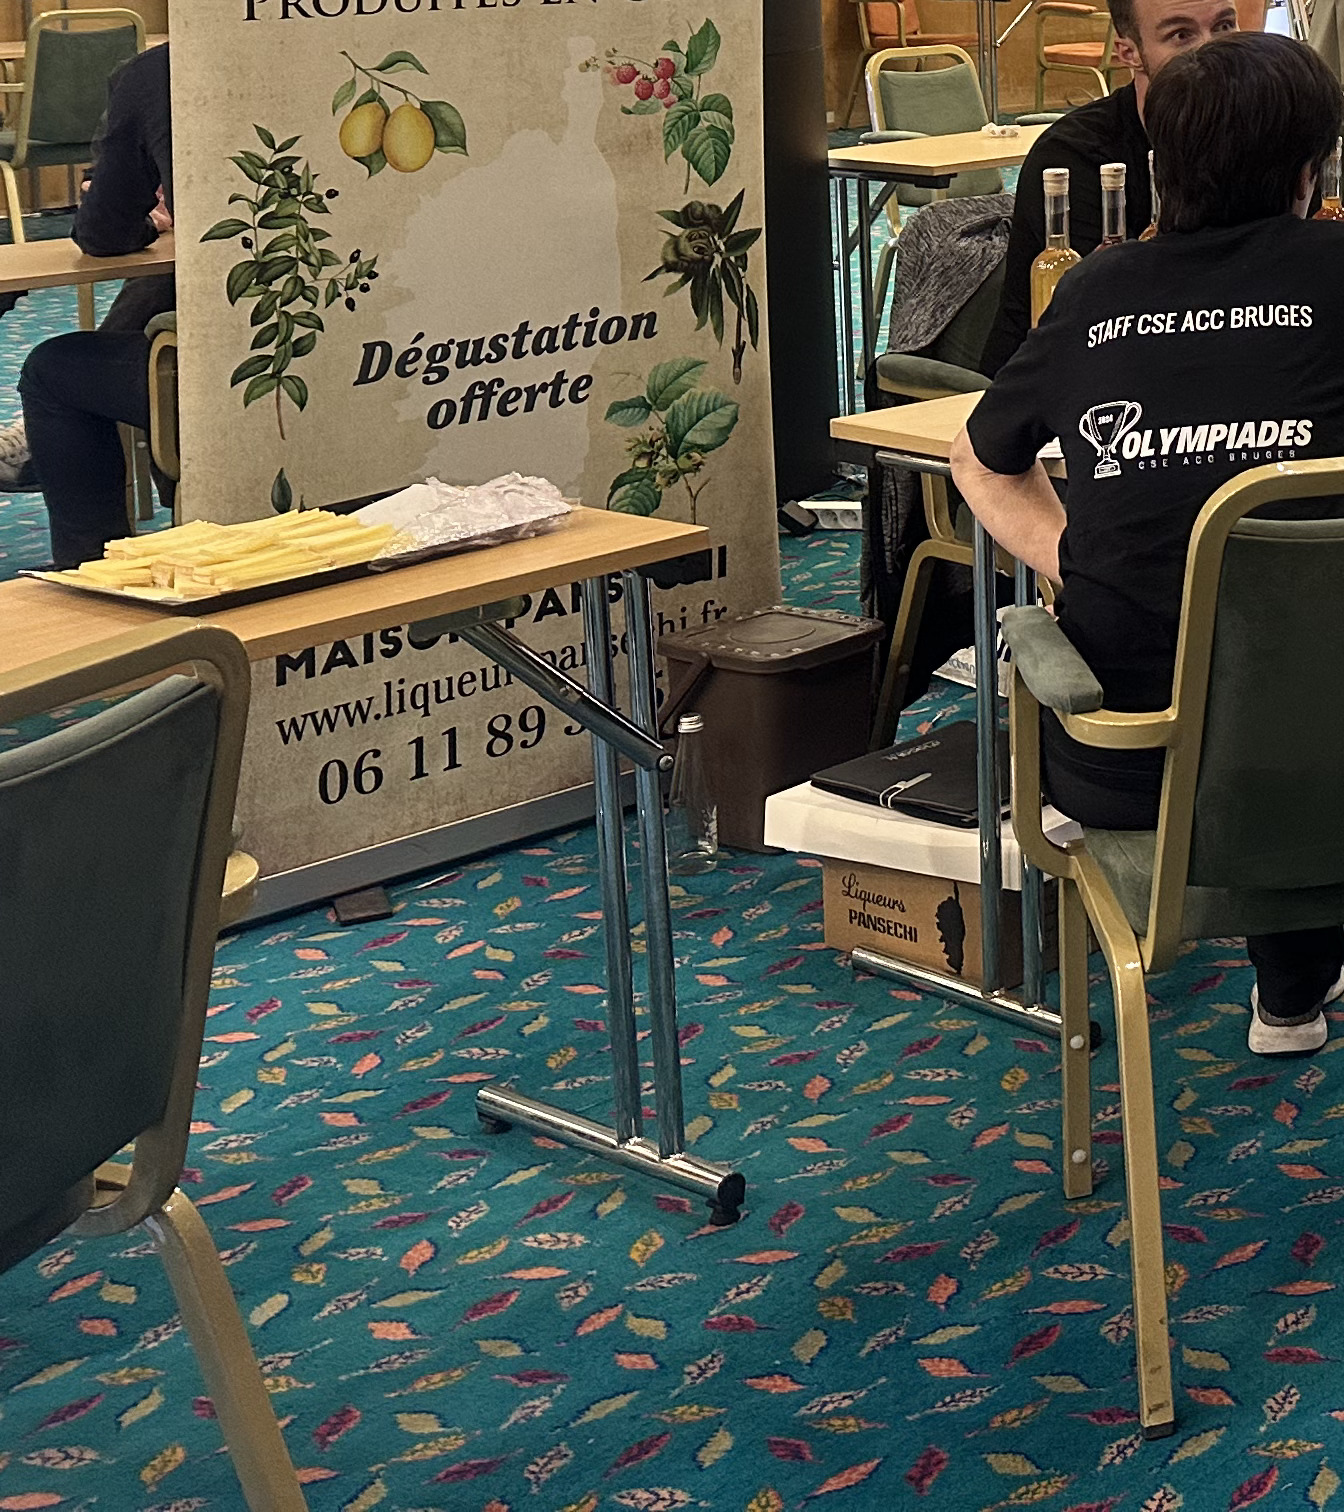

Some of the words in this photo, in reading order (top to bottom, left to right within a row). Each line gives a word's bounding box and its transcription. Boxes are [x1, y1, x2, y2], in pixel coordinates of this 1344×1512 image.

[353, 306, 657, 386] Dégustation
[1087, 314, 1134, 348] STAFF
[1137, 312, 1177, 335] CSE
[1181, 309, 1224, 332] ACC
[1230, 304, 1313, 329] BRUGES
[427, 369, 593, 430] offerte
[1122, 419, 1313, 460] OLYMPIADES
[1138, 458, 1169, 470] CSE
[1182, 455, 1215, 466] ACC
[1229, 449, 1296, 462] BRUGES
[318, 749, 384, 805] 06
[407, 726, 462, 781] 11
[485, 705, 546, 758] 89
[841, 873, 907, 913] Liqueurs
[848, 909, 918, 943] PANSECHI
